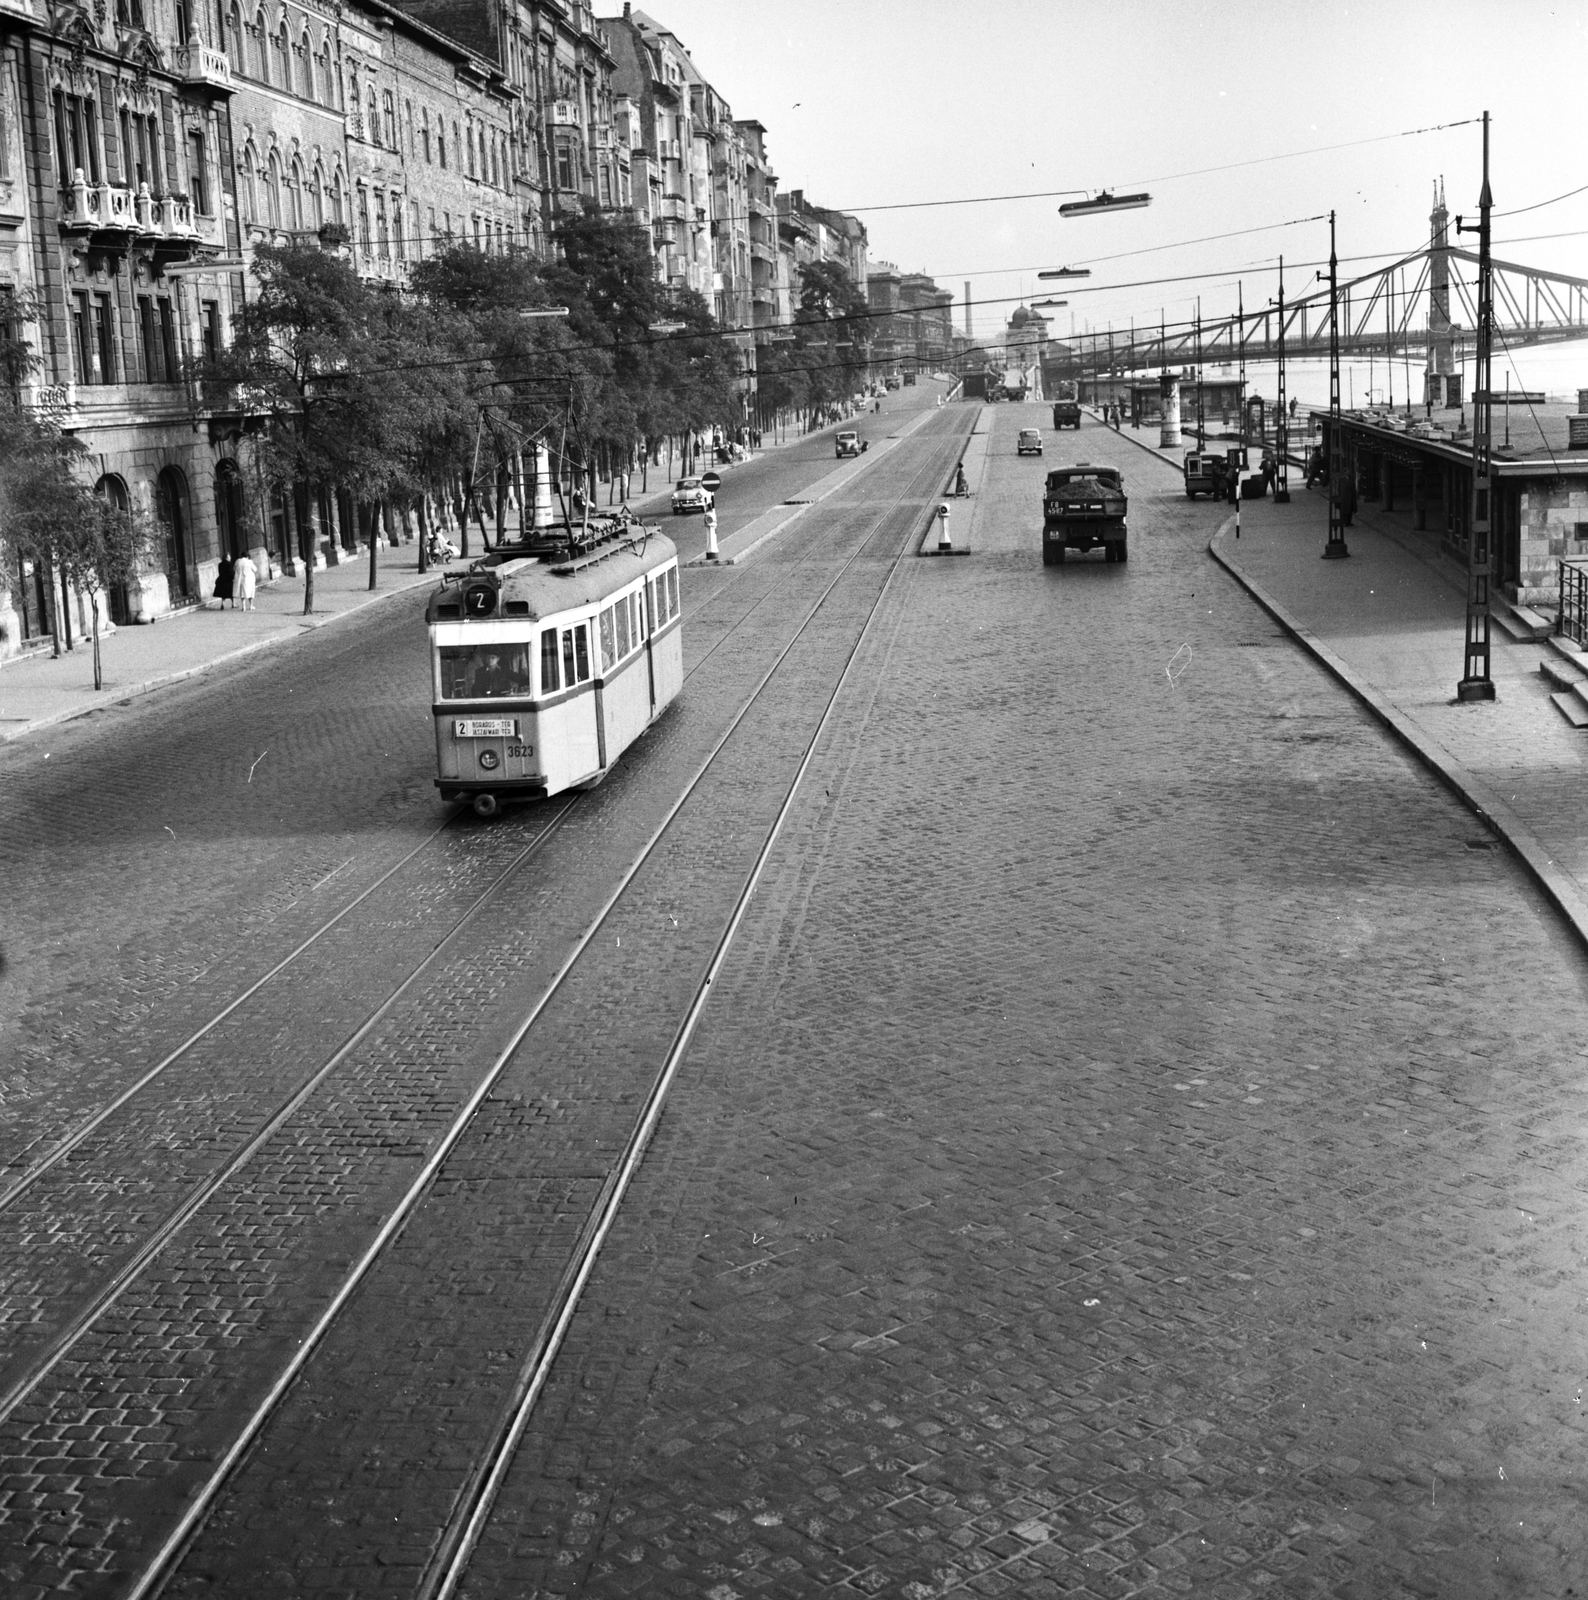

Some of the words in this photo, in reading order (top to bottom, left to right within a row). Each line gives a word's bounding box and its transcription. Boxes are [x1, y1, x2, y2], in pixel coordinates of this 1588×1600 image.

[476, 592, 485, 608] 2
[459, 722, 466, 735] 2
[508, 745, 533, 757] 3623
